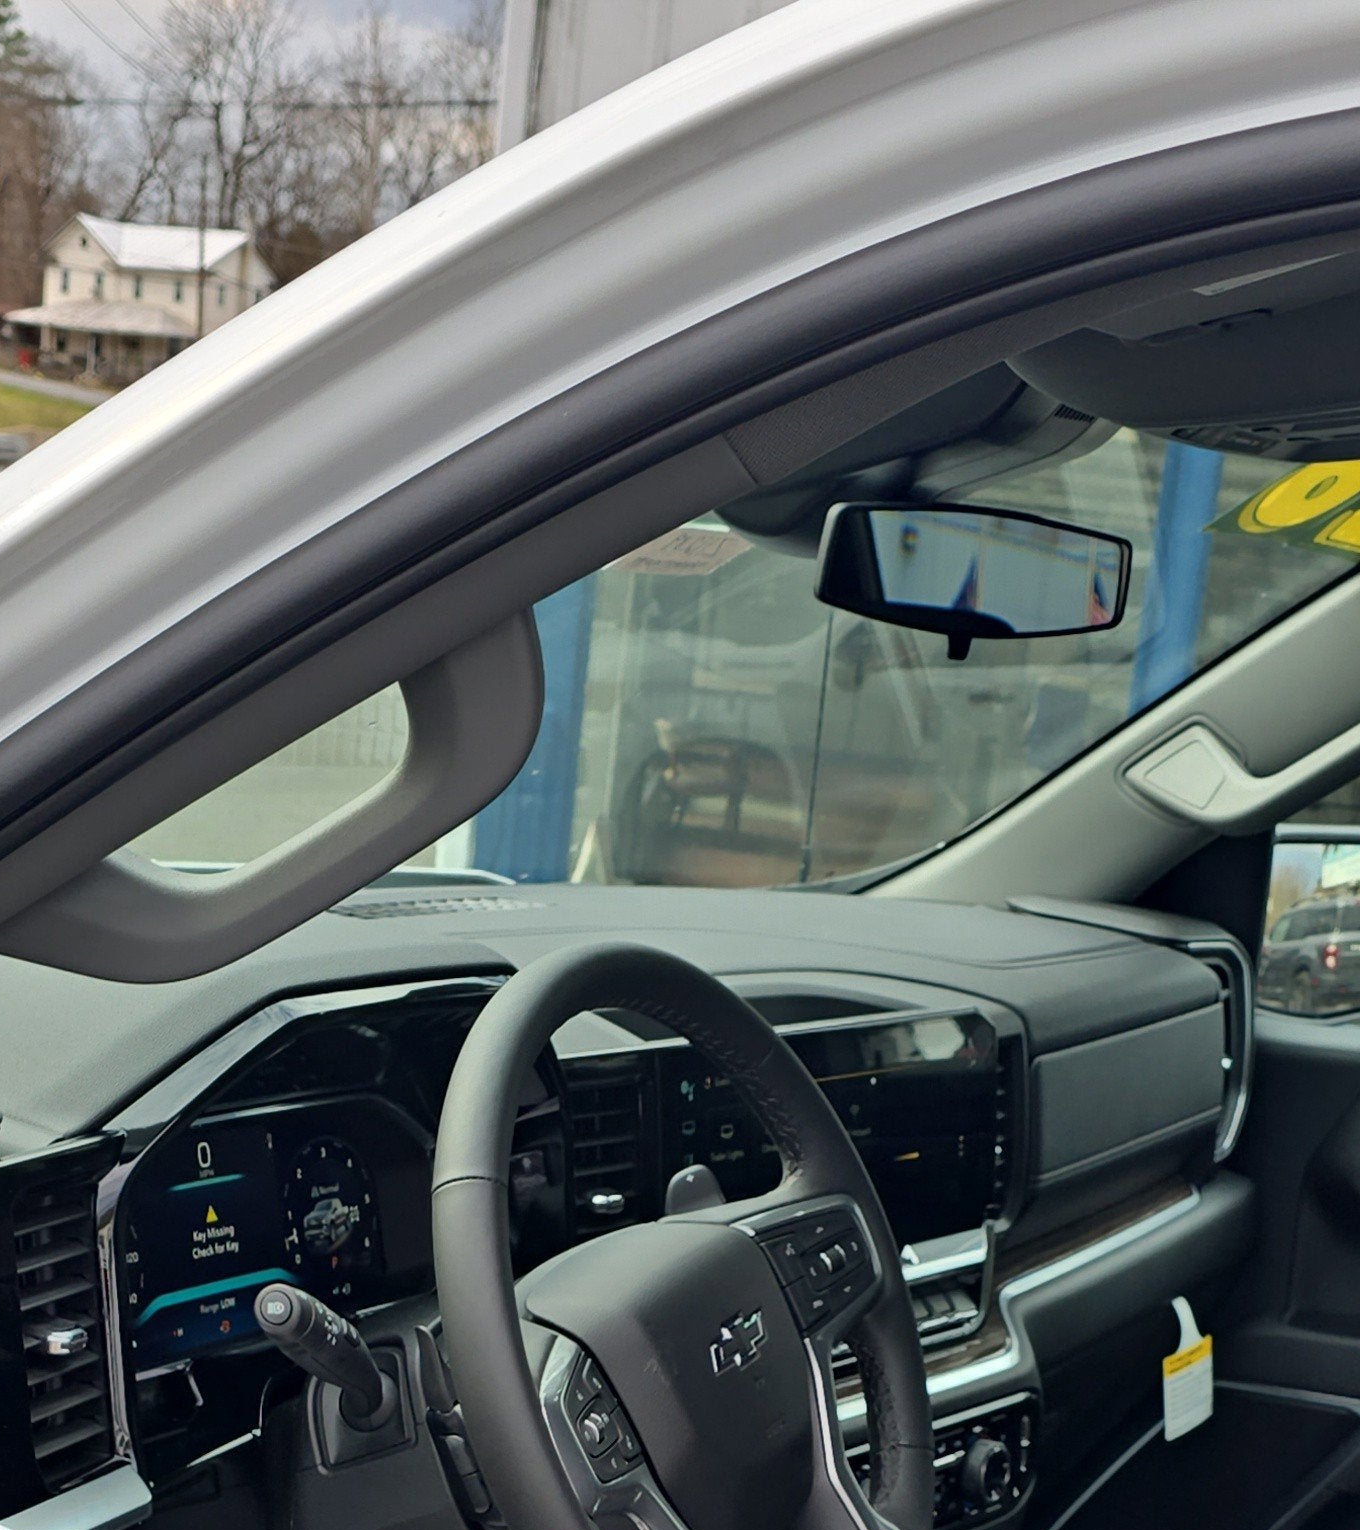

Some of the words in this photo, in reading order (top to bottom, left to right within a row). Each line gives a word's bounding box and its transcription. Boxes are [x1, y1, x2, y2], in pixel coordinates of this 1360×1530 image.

[197, 1141, 212, 1169] 0
[192, 1230, 206, 1243] Key
[207, 1225, 235, 1238] Missing
[192, 1243, 215, 1259] Check
[215, 1242, 225, 1254] for
[226, 1241, 239, 1253] Key
